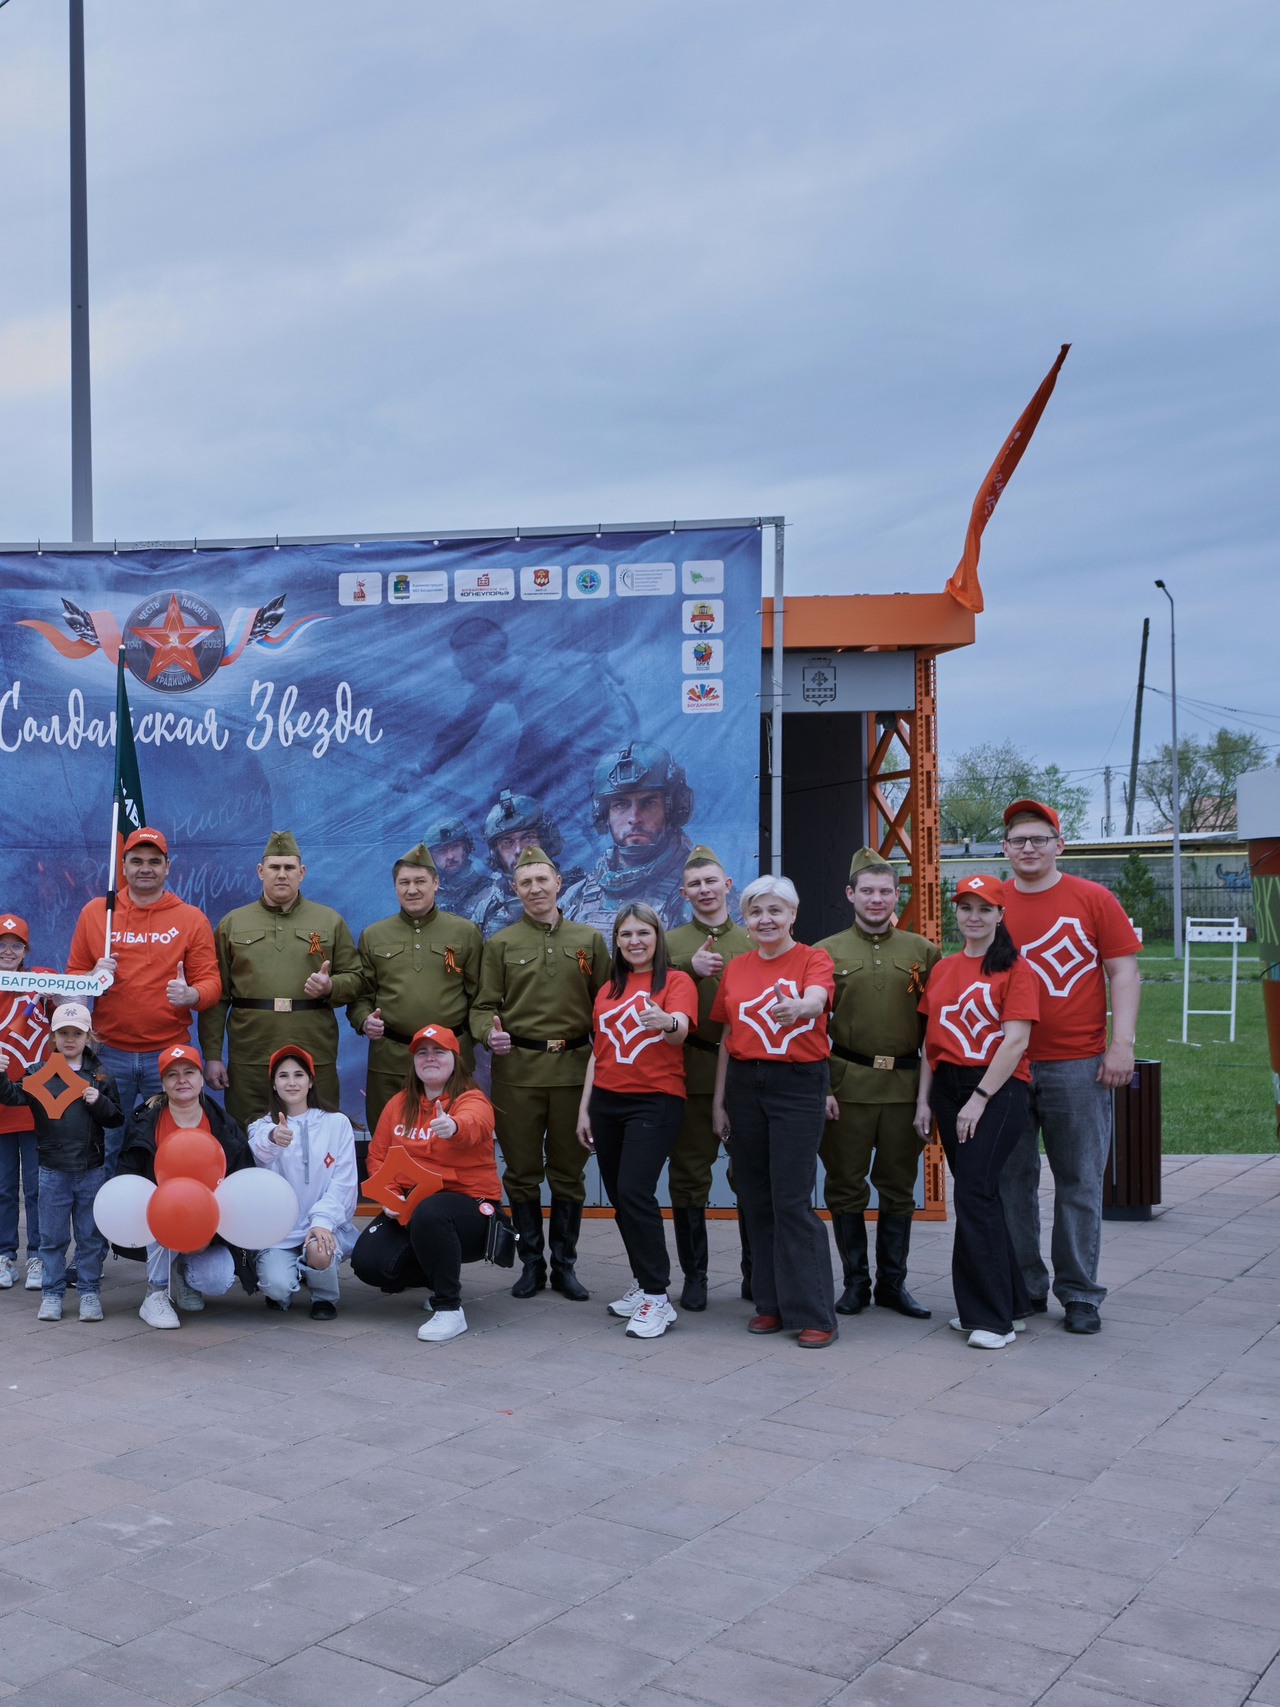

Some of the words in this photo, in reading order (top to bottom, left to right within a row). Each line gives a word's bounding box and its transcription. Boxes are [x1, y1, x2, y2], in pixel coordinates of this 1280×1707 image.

[138, 601, 161, 621] ЧЕСТЬ
[181, 598, 210, 621] ПАМЯТЬ
[156, 674, 193, 687] ТРАДИЦИИ
[246, 679, 384, 759] Звезда
[1253, 876, 1280, 946] ВК
[111, 931, 172, 945] СИБАГРО
